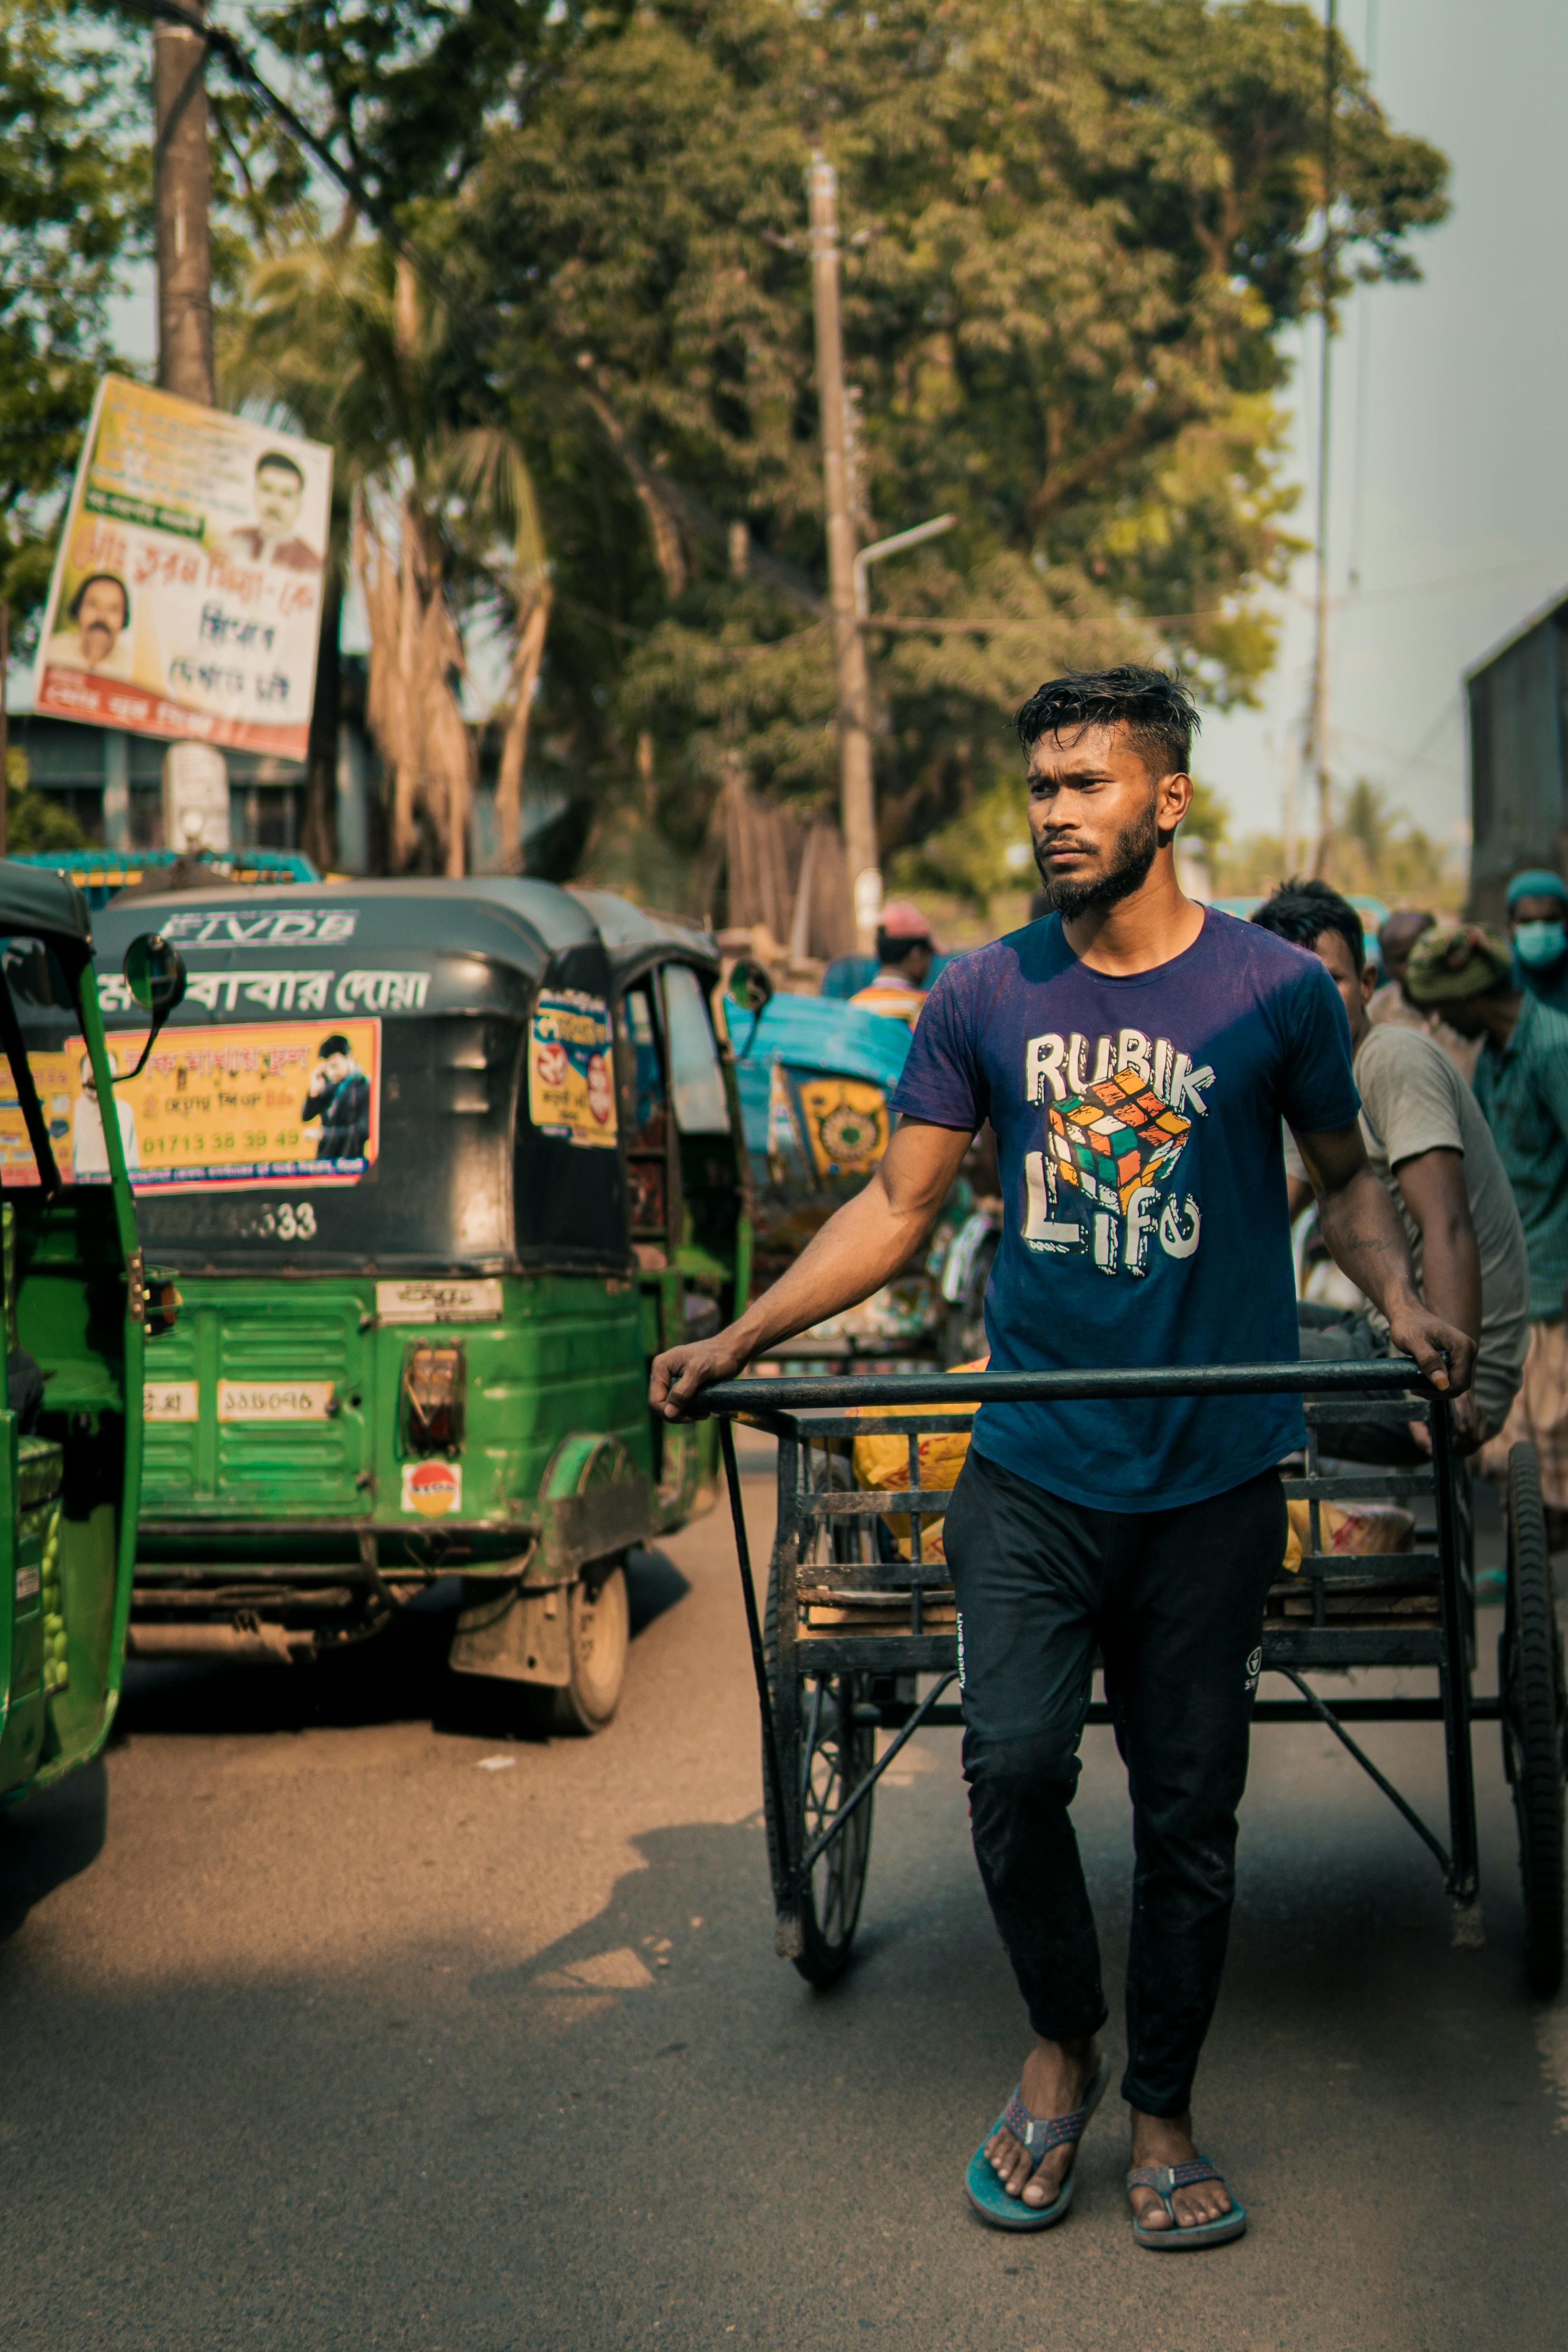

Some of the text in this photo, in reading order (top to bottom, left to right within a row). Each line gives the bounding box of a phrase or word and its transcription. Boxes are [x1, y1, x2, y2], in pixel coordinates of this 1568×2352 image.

[184, 969, 335, 1013] বাবার
[335, 969, 431, 1013] দোয়া
[1025, 1028, 1216, 1118] RUBIK
[143, 1133, 204, 1155] 01713
[274, 1128, 300, 1150] 49
